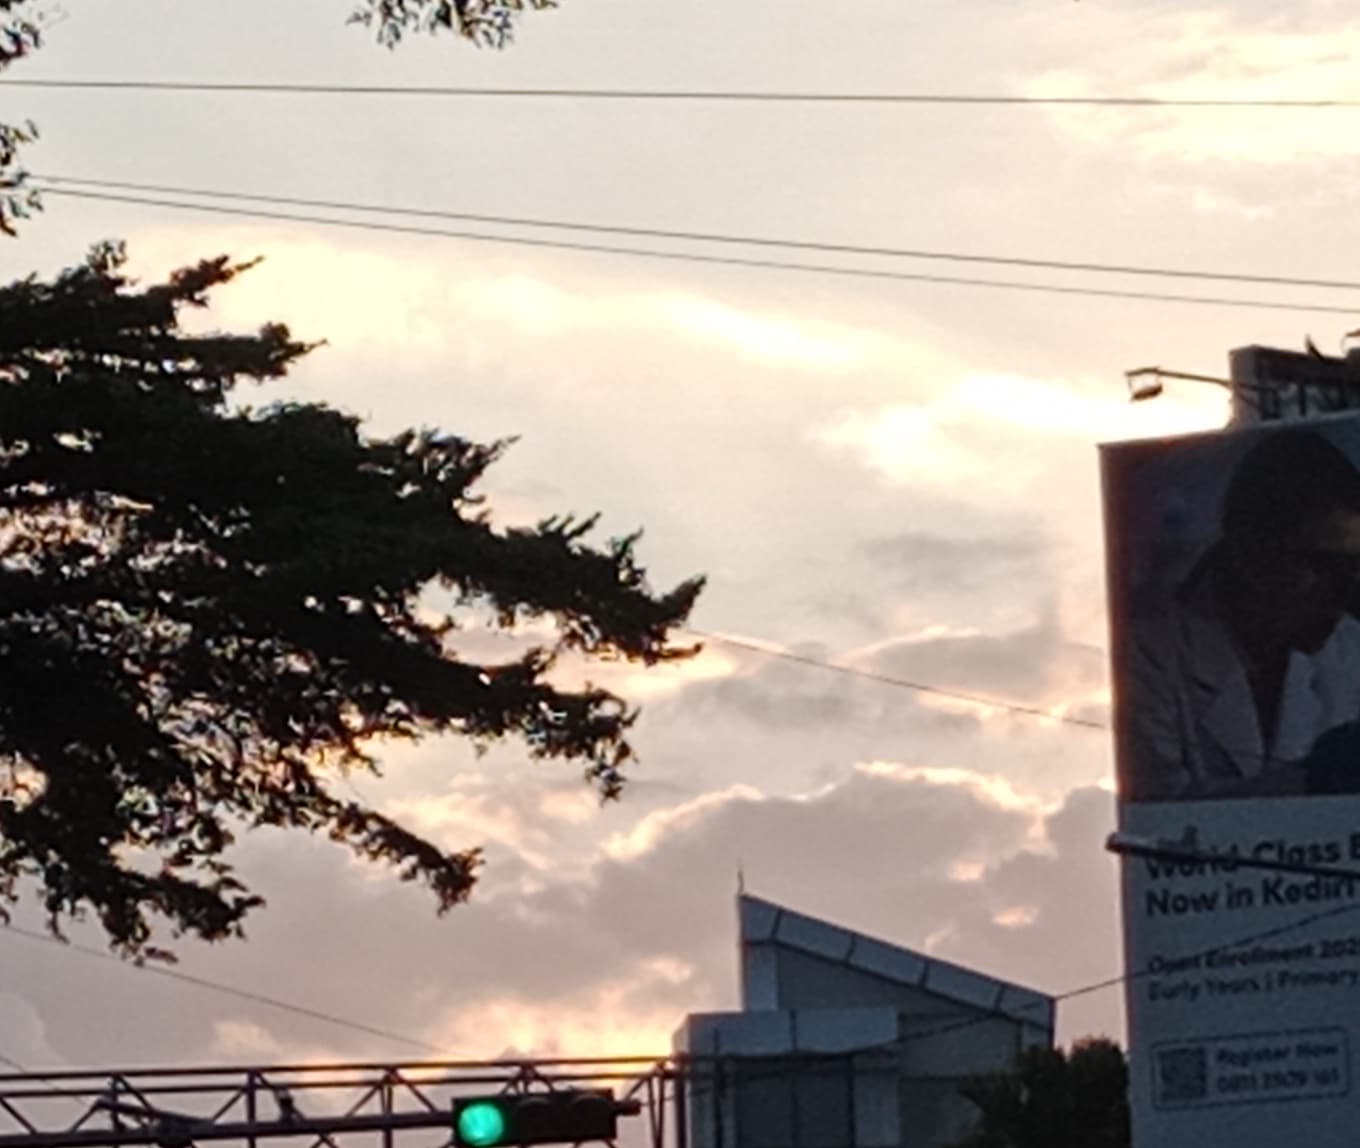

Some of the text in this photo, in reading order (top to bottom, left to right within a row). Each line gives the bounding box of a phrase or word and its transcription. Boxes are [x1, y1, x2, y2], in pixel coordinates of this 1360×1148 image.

[1252, 838, 1340, 867] Class
[1146, 887, 1217, 917] Now
[1224, 881, 1253, 909] in
